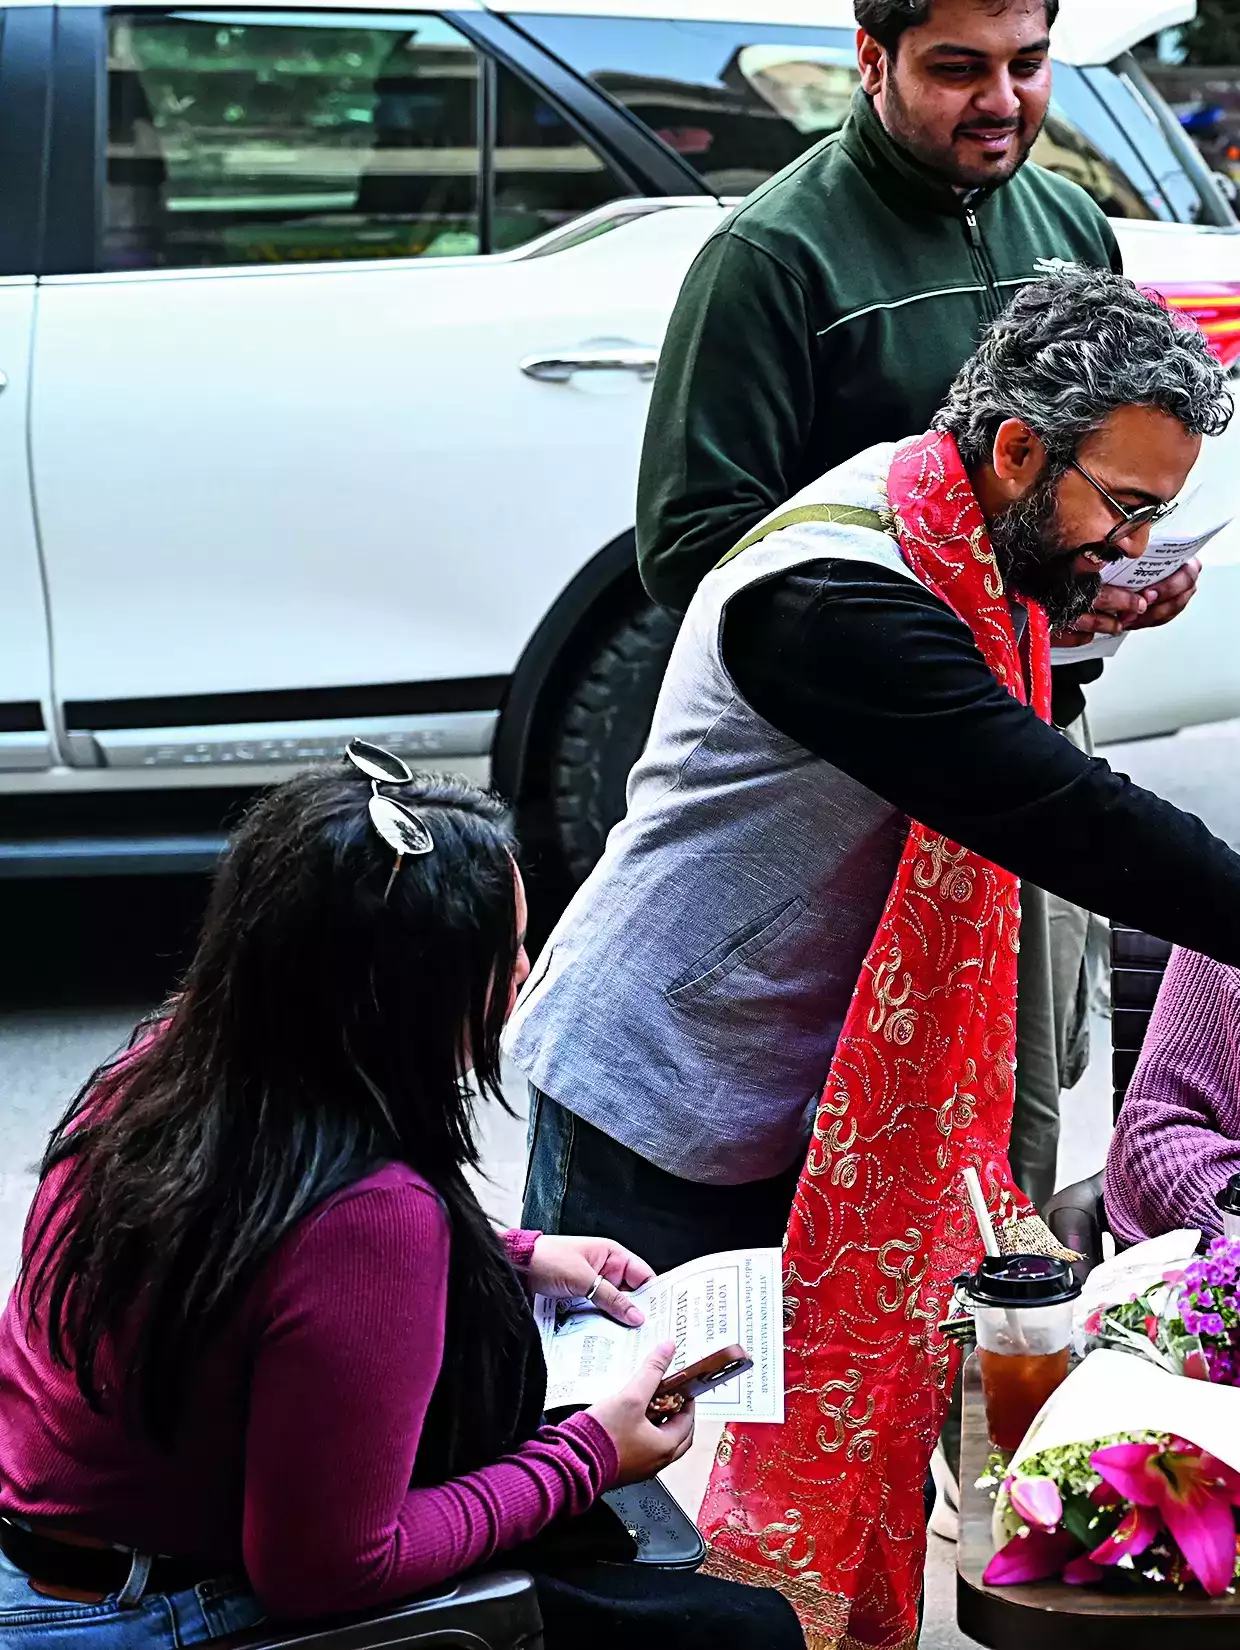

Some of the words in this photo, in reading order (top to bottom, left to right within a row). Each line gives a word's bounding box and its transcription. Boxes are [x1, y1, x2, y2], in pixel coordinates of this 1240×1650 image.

[706, 1279, 714, 1301] THIS
[719, 1284, 727, 1312] VOTE
[674, 1290, 688, 1371] MEGHNAD
[706, 1303, 715, 1343] SYMBOL
[719, 1314, 727, 1334] FOR
[745, 1305, 753, 1352] YOUTUBER
